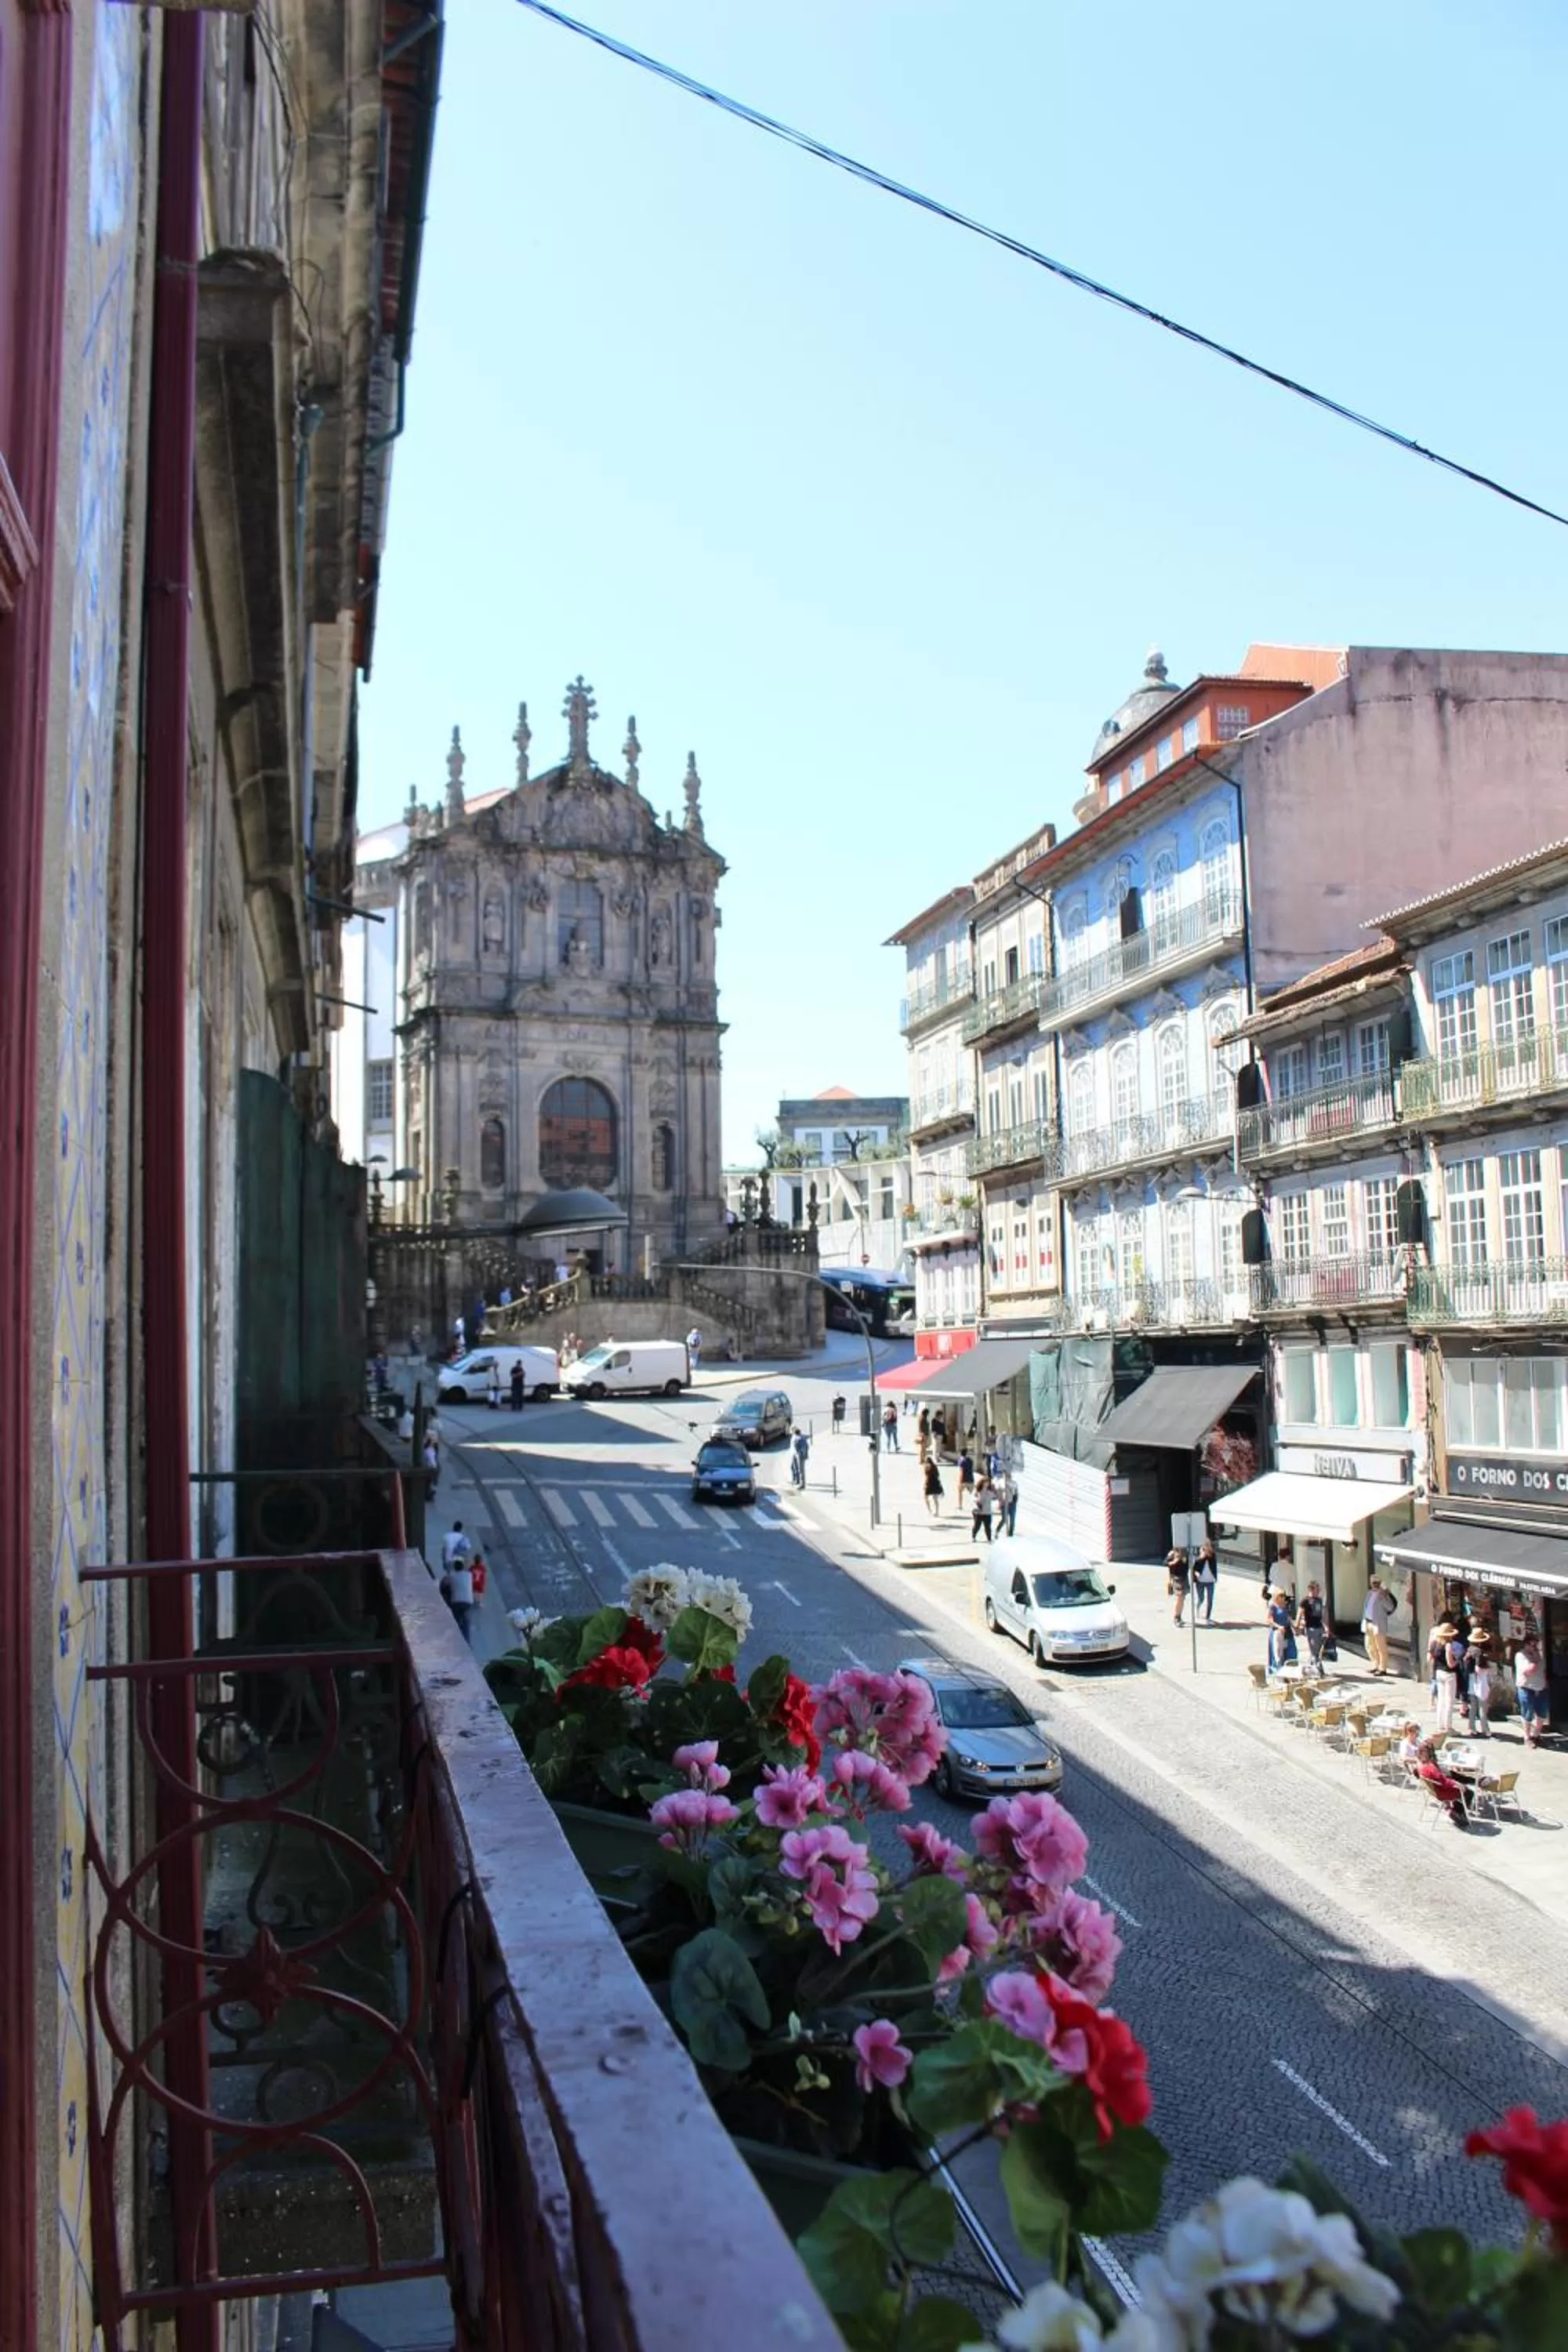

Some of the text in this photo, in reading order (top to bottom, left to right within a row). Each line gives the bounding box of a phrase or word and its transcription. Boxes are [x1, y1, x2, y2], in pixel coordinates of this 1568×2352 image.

[1457, 1465, 1466, 1482] O
[1472, 1467, 1517, 1486] FORNO
[1523, 1469, 1550, 1490] DOS
